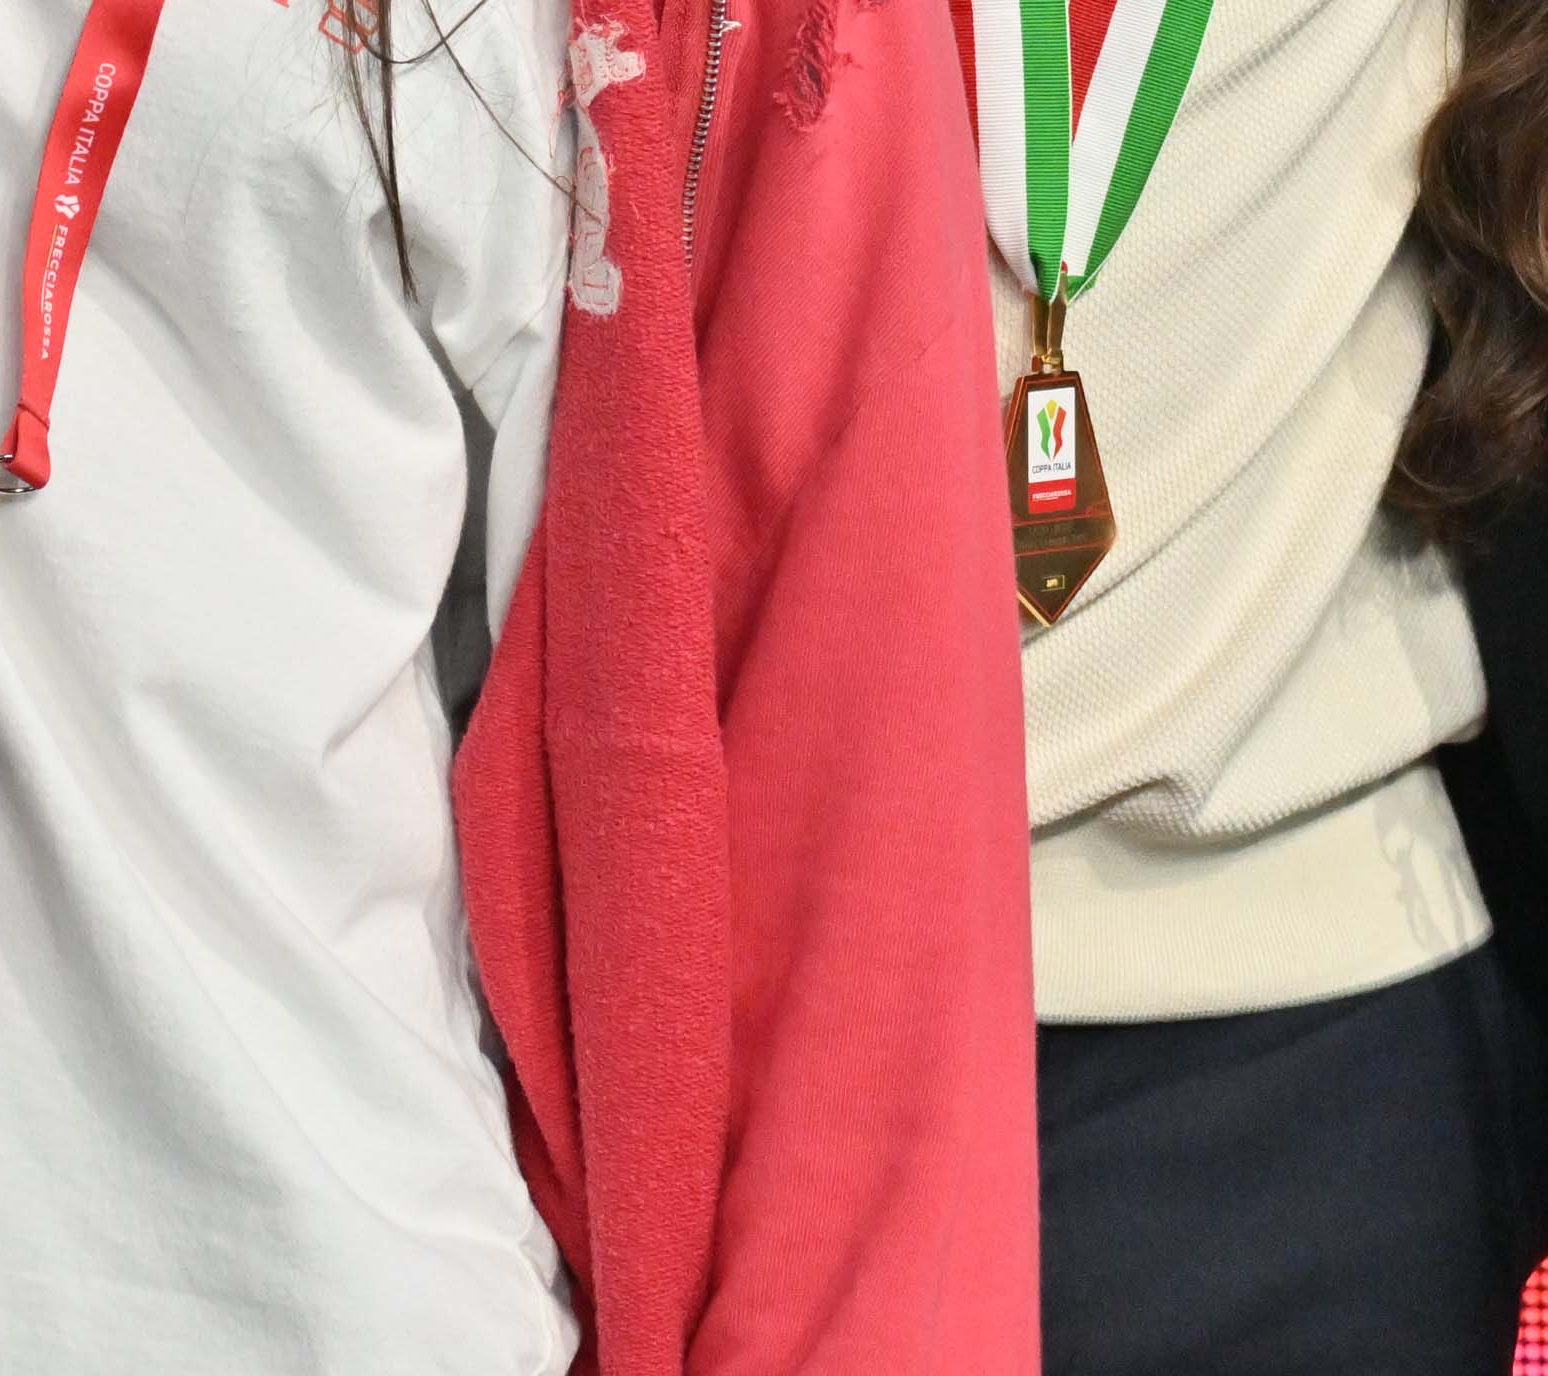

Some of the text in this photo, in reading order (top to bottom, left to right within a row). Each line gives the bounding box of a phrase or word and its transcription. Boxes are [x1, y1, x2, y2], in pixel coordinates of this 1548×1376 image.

[42, 63, 116, 359] COPPA ITALIA FRECCIAROSSA
